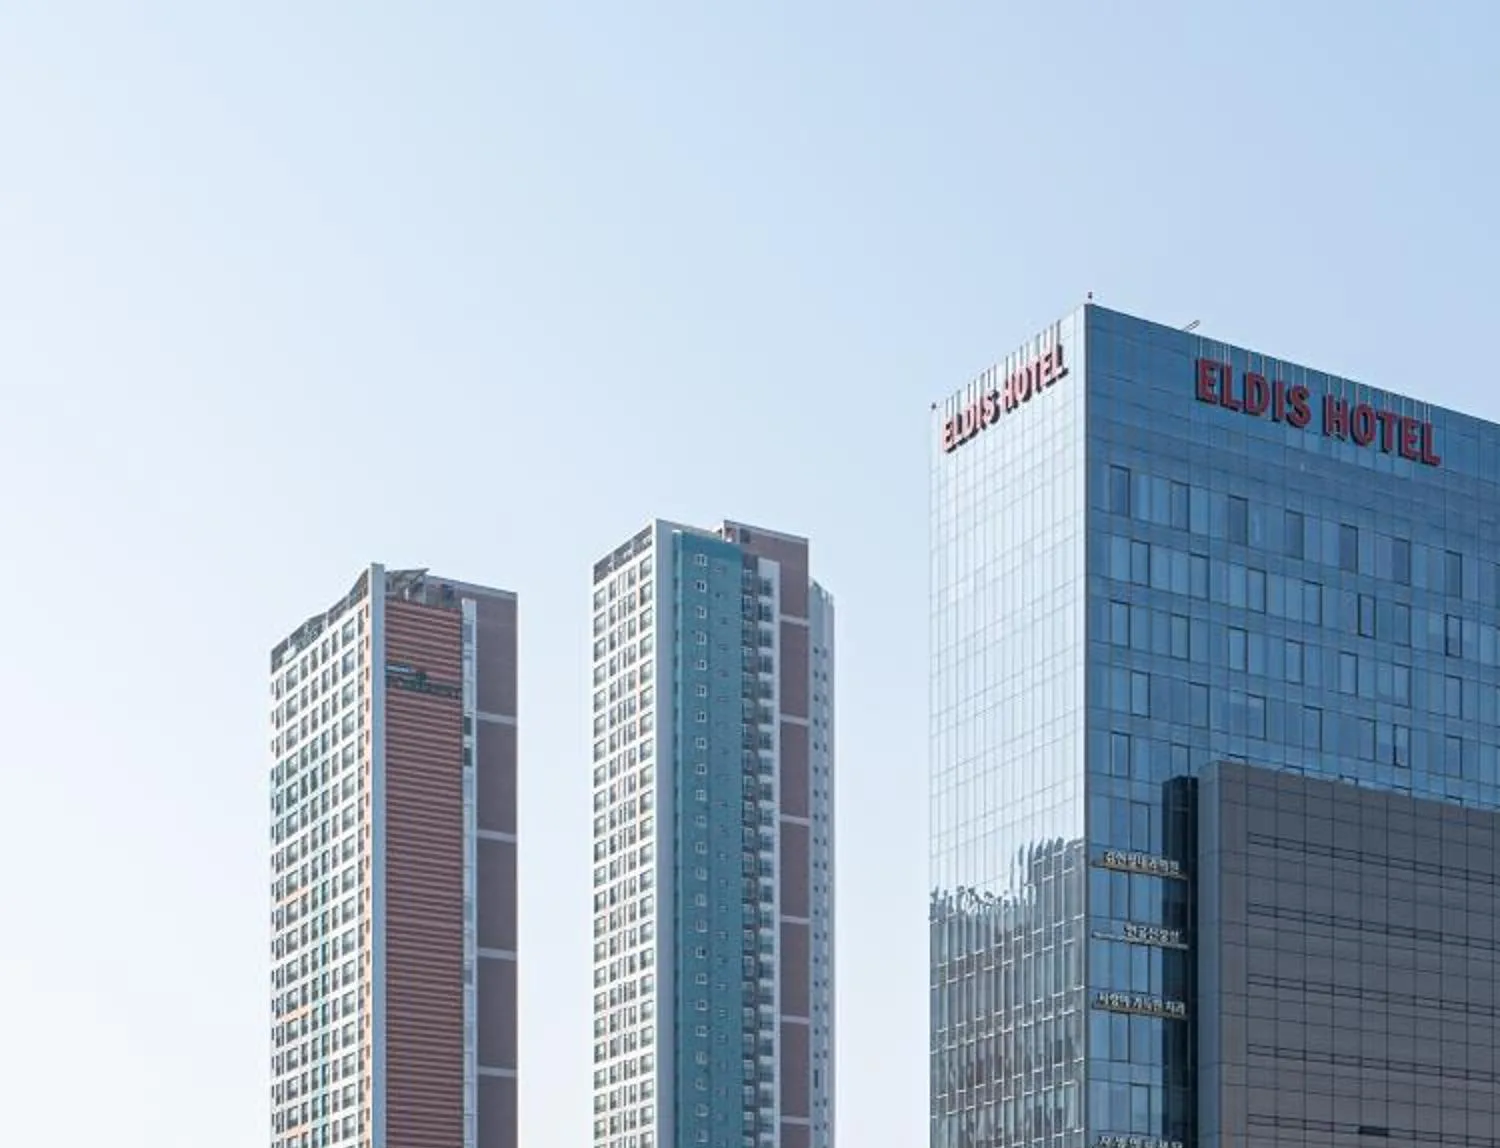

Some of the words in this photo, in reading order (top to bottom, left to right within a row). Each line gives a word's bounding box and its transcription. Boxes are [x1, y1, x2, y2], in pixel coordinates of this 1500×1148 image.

[942, 388, 1000, 453] ELDIS
[999, 343, 1069, 412] HOTEL
[1195, 357, 1312, 429] ELDIS
[1322, 392, 1442, 467] HOTEL
